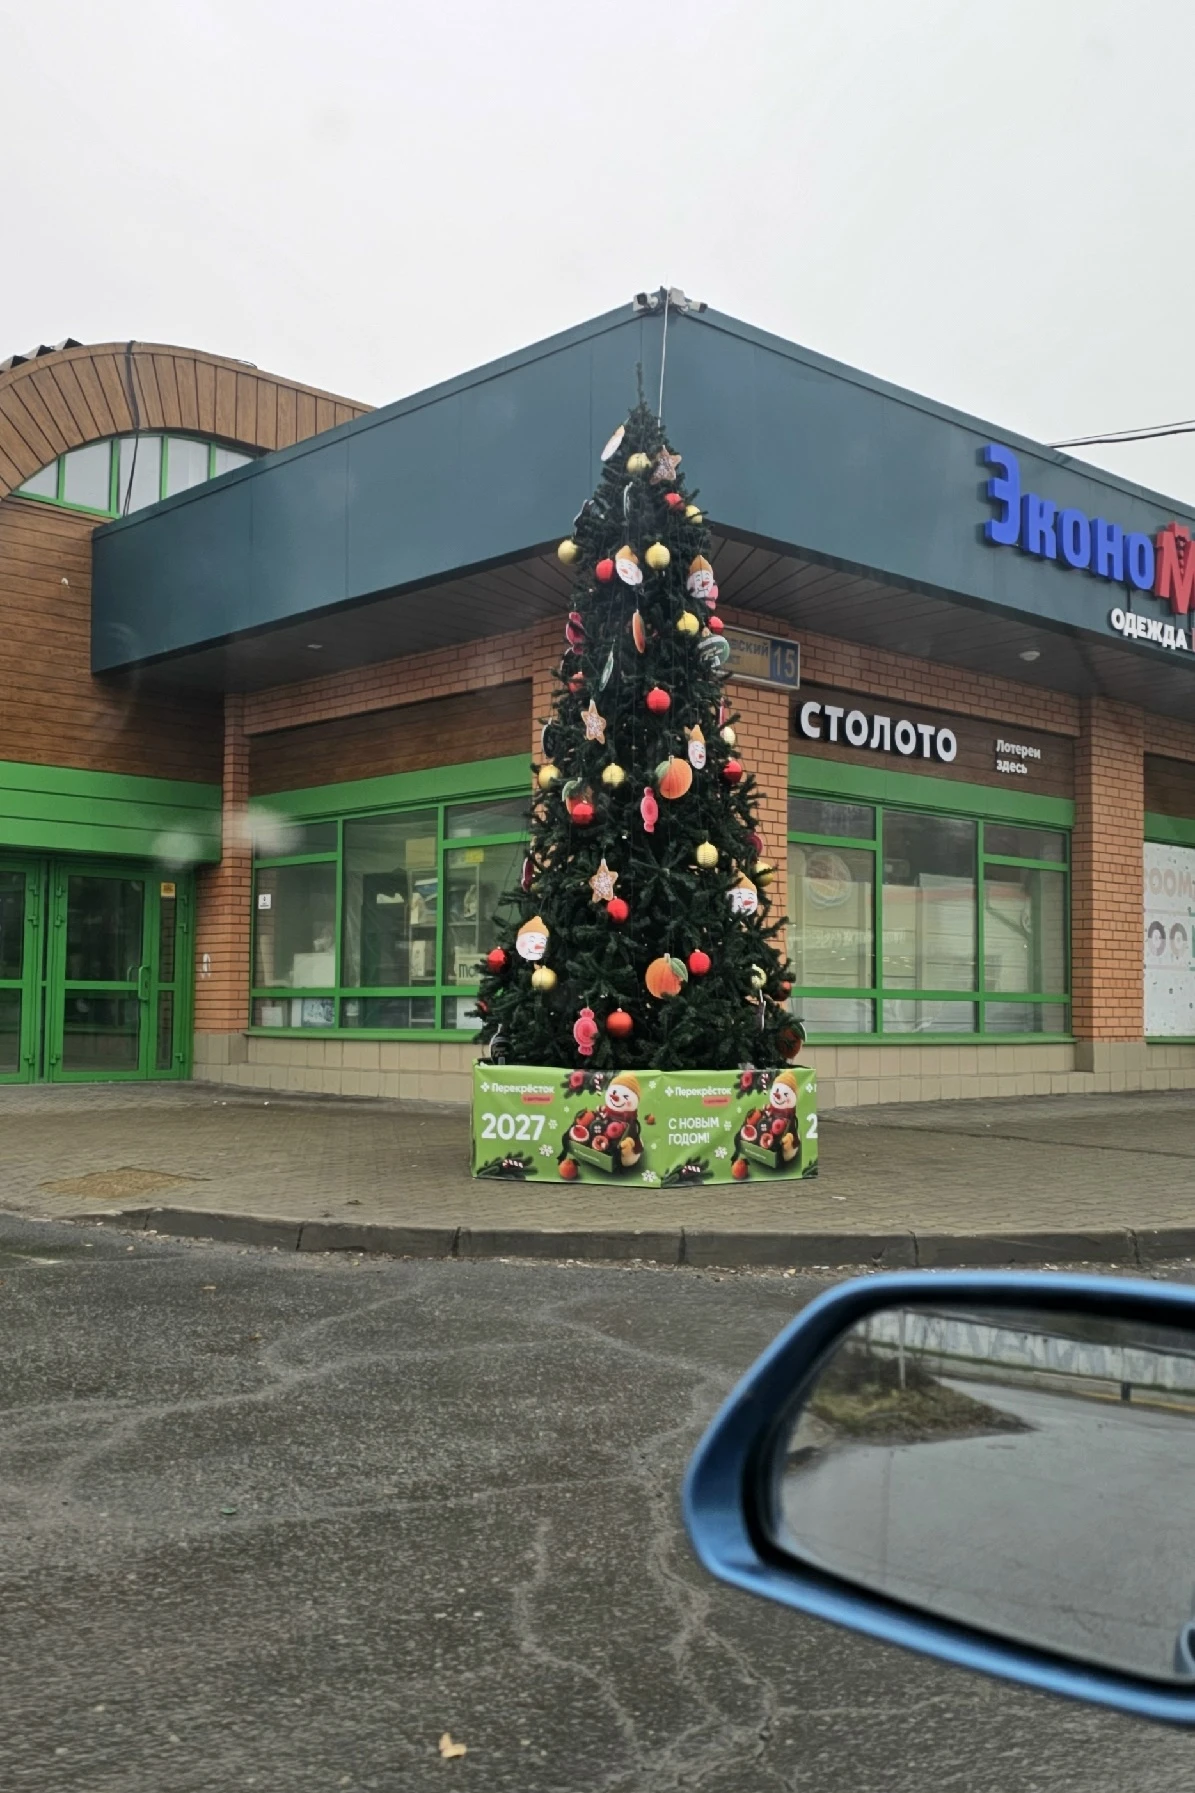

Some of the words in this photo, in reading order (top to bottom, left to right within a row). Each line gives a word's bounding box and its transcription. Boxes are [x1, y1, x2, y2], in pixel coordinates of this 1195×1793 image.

[1111, 607, 1188, 650] ОДЕЖДА
[773, 645, 796, 678] 15
[800, 701, 957, 762] СТОЛОТО
[996, 739, 1041, 759] Лотереи
[996, 759, 1028, 774] здесь
[481, 1112, 546, 1141] 2027
[668, 1118, 677, 1130] С
[679, 1116, 720, 1130] НОВЫМ
[668, 1132, 710, 1146] ГОДОМ!
